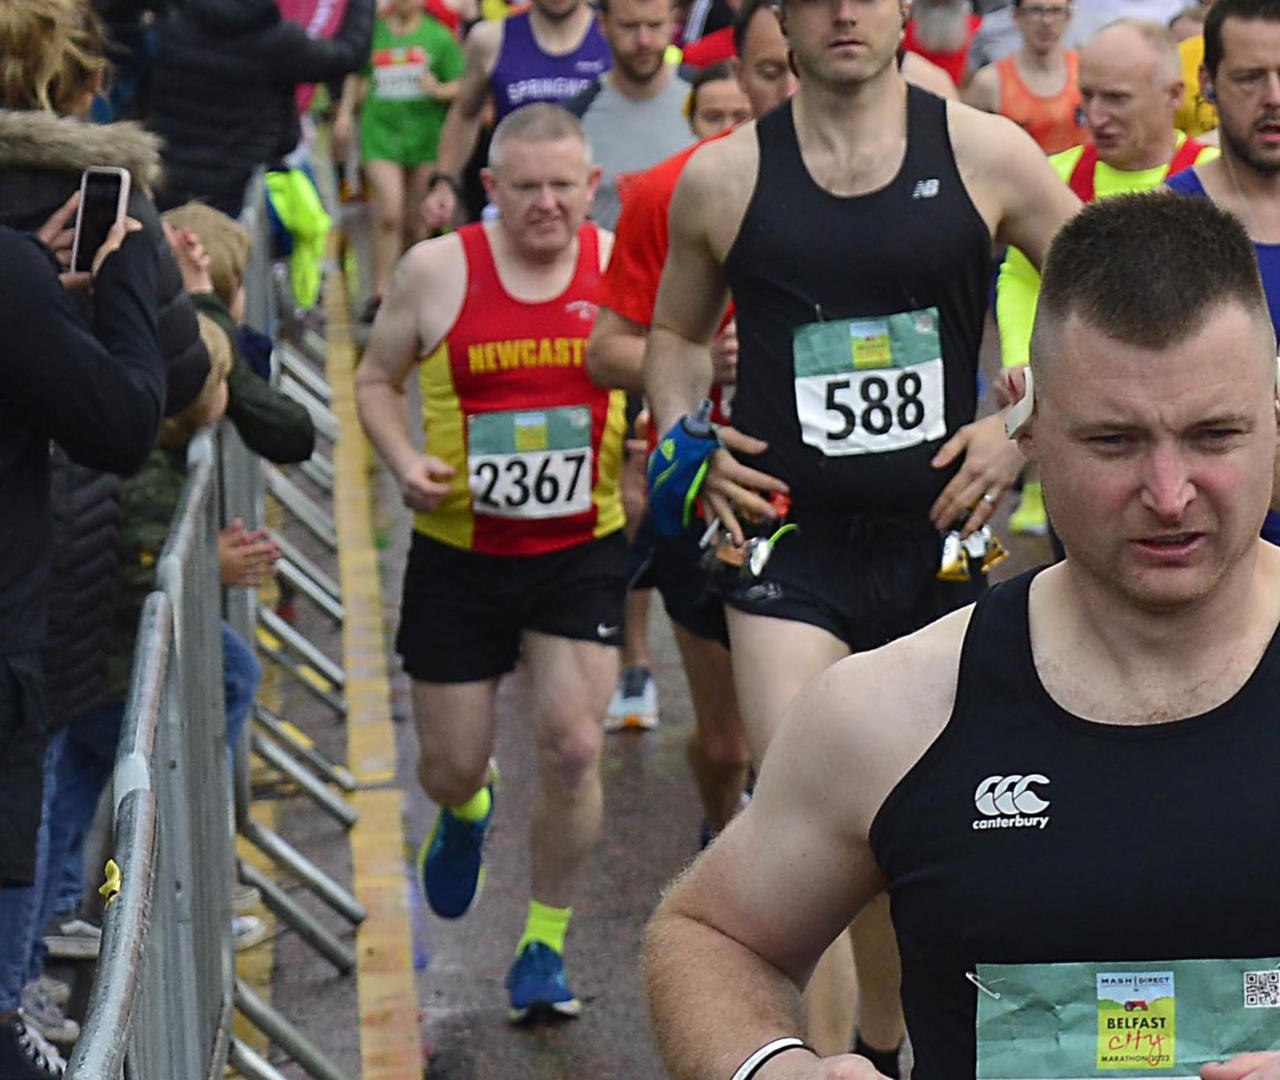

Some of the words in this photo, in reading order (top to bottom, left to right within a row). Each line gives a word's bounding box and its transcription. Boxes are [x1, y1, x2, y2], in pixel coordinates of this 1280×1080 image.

[824, 372, 925, 440] 588
[475, 454, 586, 508] 2367
[972, 815, 1049, 830] canterbury
[1101, 977, 1132, 985] MASH
[1139, 976, 1170, 985] DIRECT
[1107, 1017, 1166, 1029] BELFAST
